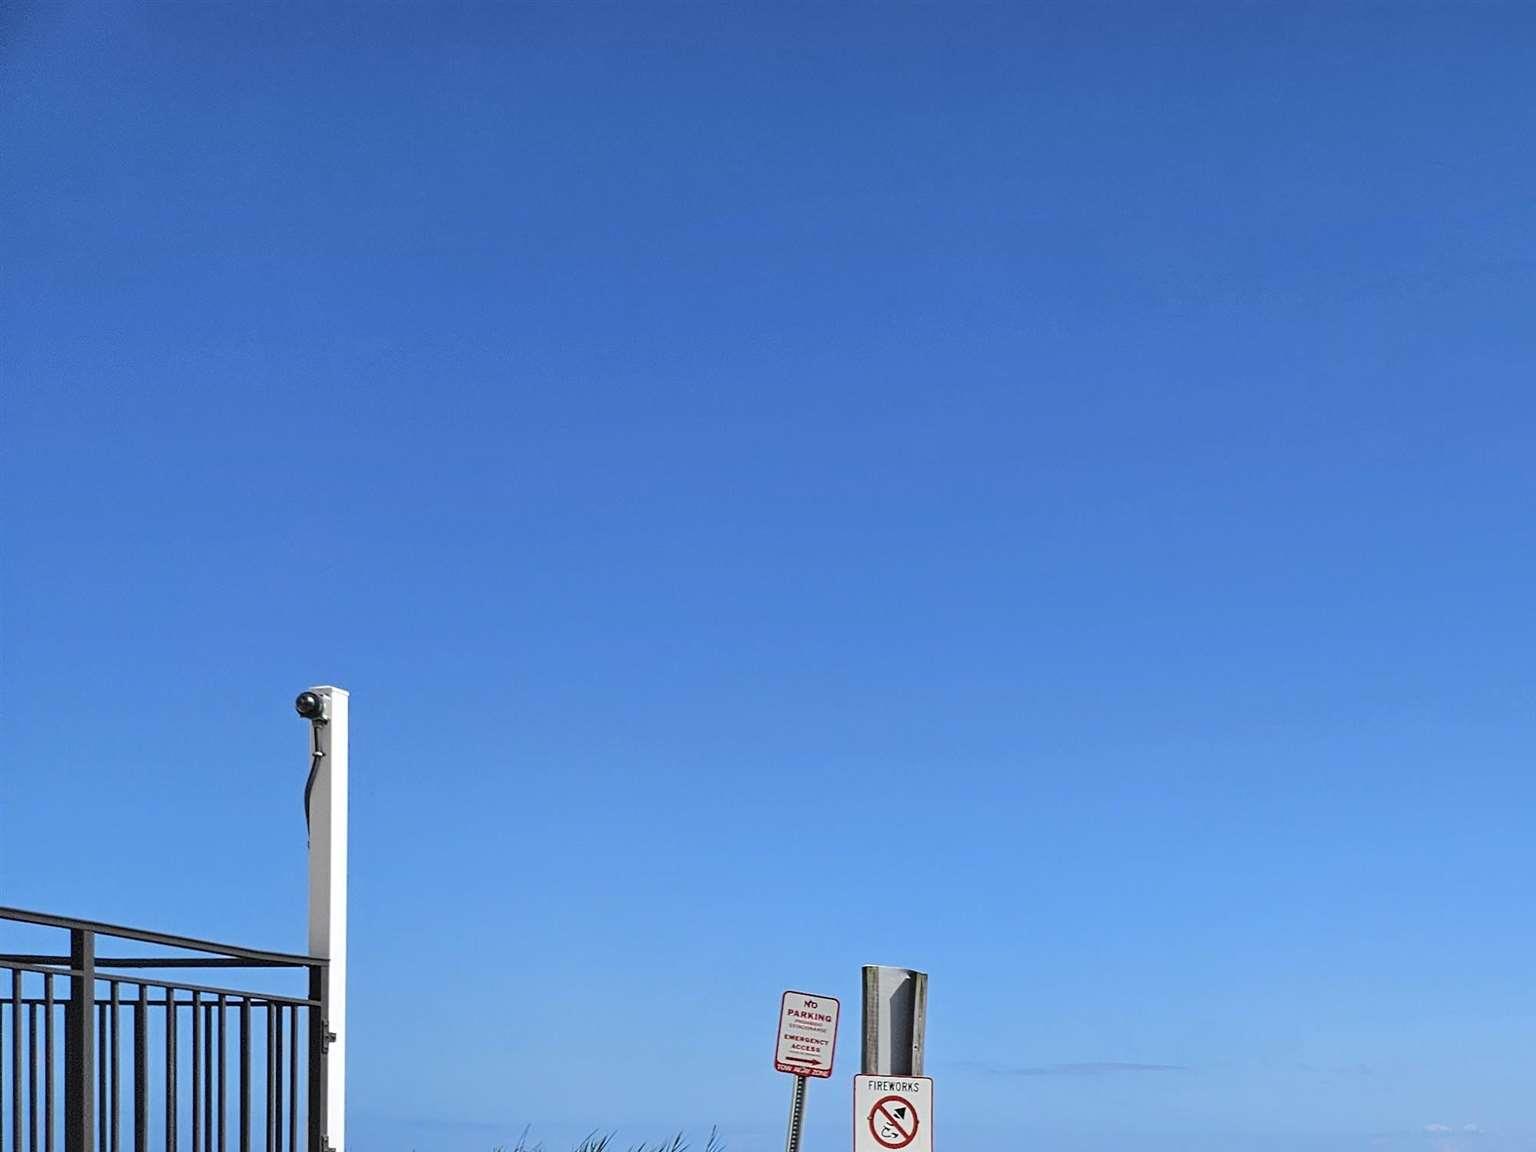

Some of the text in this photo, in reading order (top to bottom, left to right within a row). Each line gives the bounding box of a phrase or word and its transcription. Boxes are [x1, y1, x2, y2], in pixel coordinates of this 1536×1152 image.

[804, 1000, 818, 1009] NO
[787, 1008, 832, 1022] PARKING
[784, 1034, 829, 1046] EMERGENCY
[791, 1043, 821, 1053] ACCESS
[868, 1080, 920, 1093] FIREWORKS
